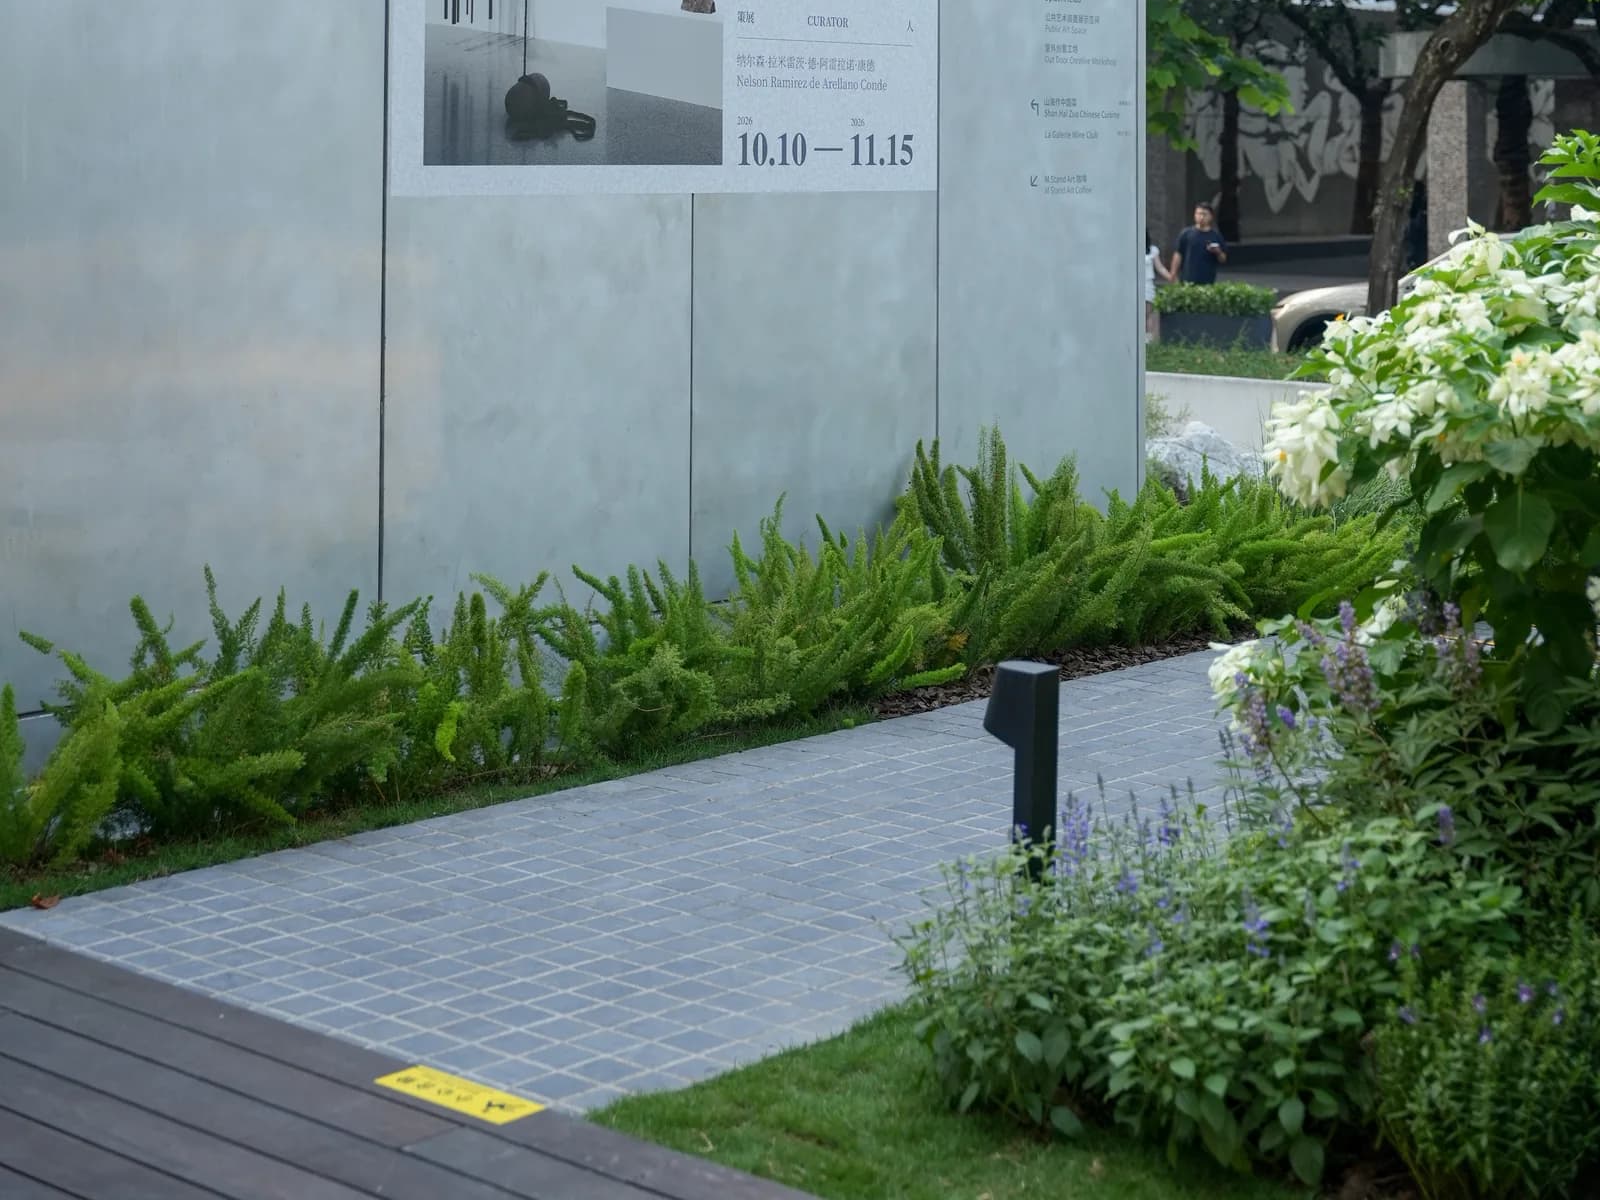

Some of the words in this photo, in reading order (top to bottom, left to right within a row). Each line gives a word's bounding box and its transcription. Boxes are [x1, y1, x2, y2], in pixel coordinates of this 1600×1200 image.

[807, 15, 849, 28] CURATOR
[736, 75, 768, 87] Nelson
[809, 77, 820, 89] de
[822, 77, 858, 90] Arellano
[860, 79, 888, 91] Conde
[737, 132, 807, 166] 10.10
[850, 133, 914, 166] 11.15
